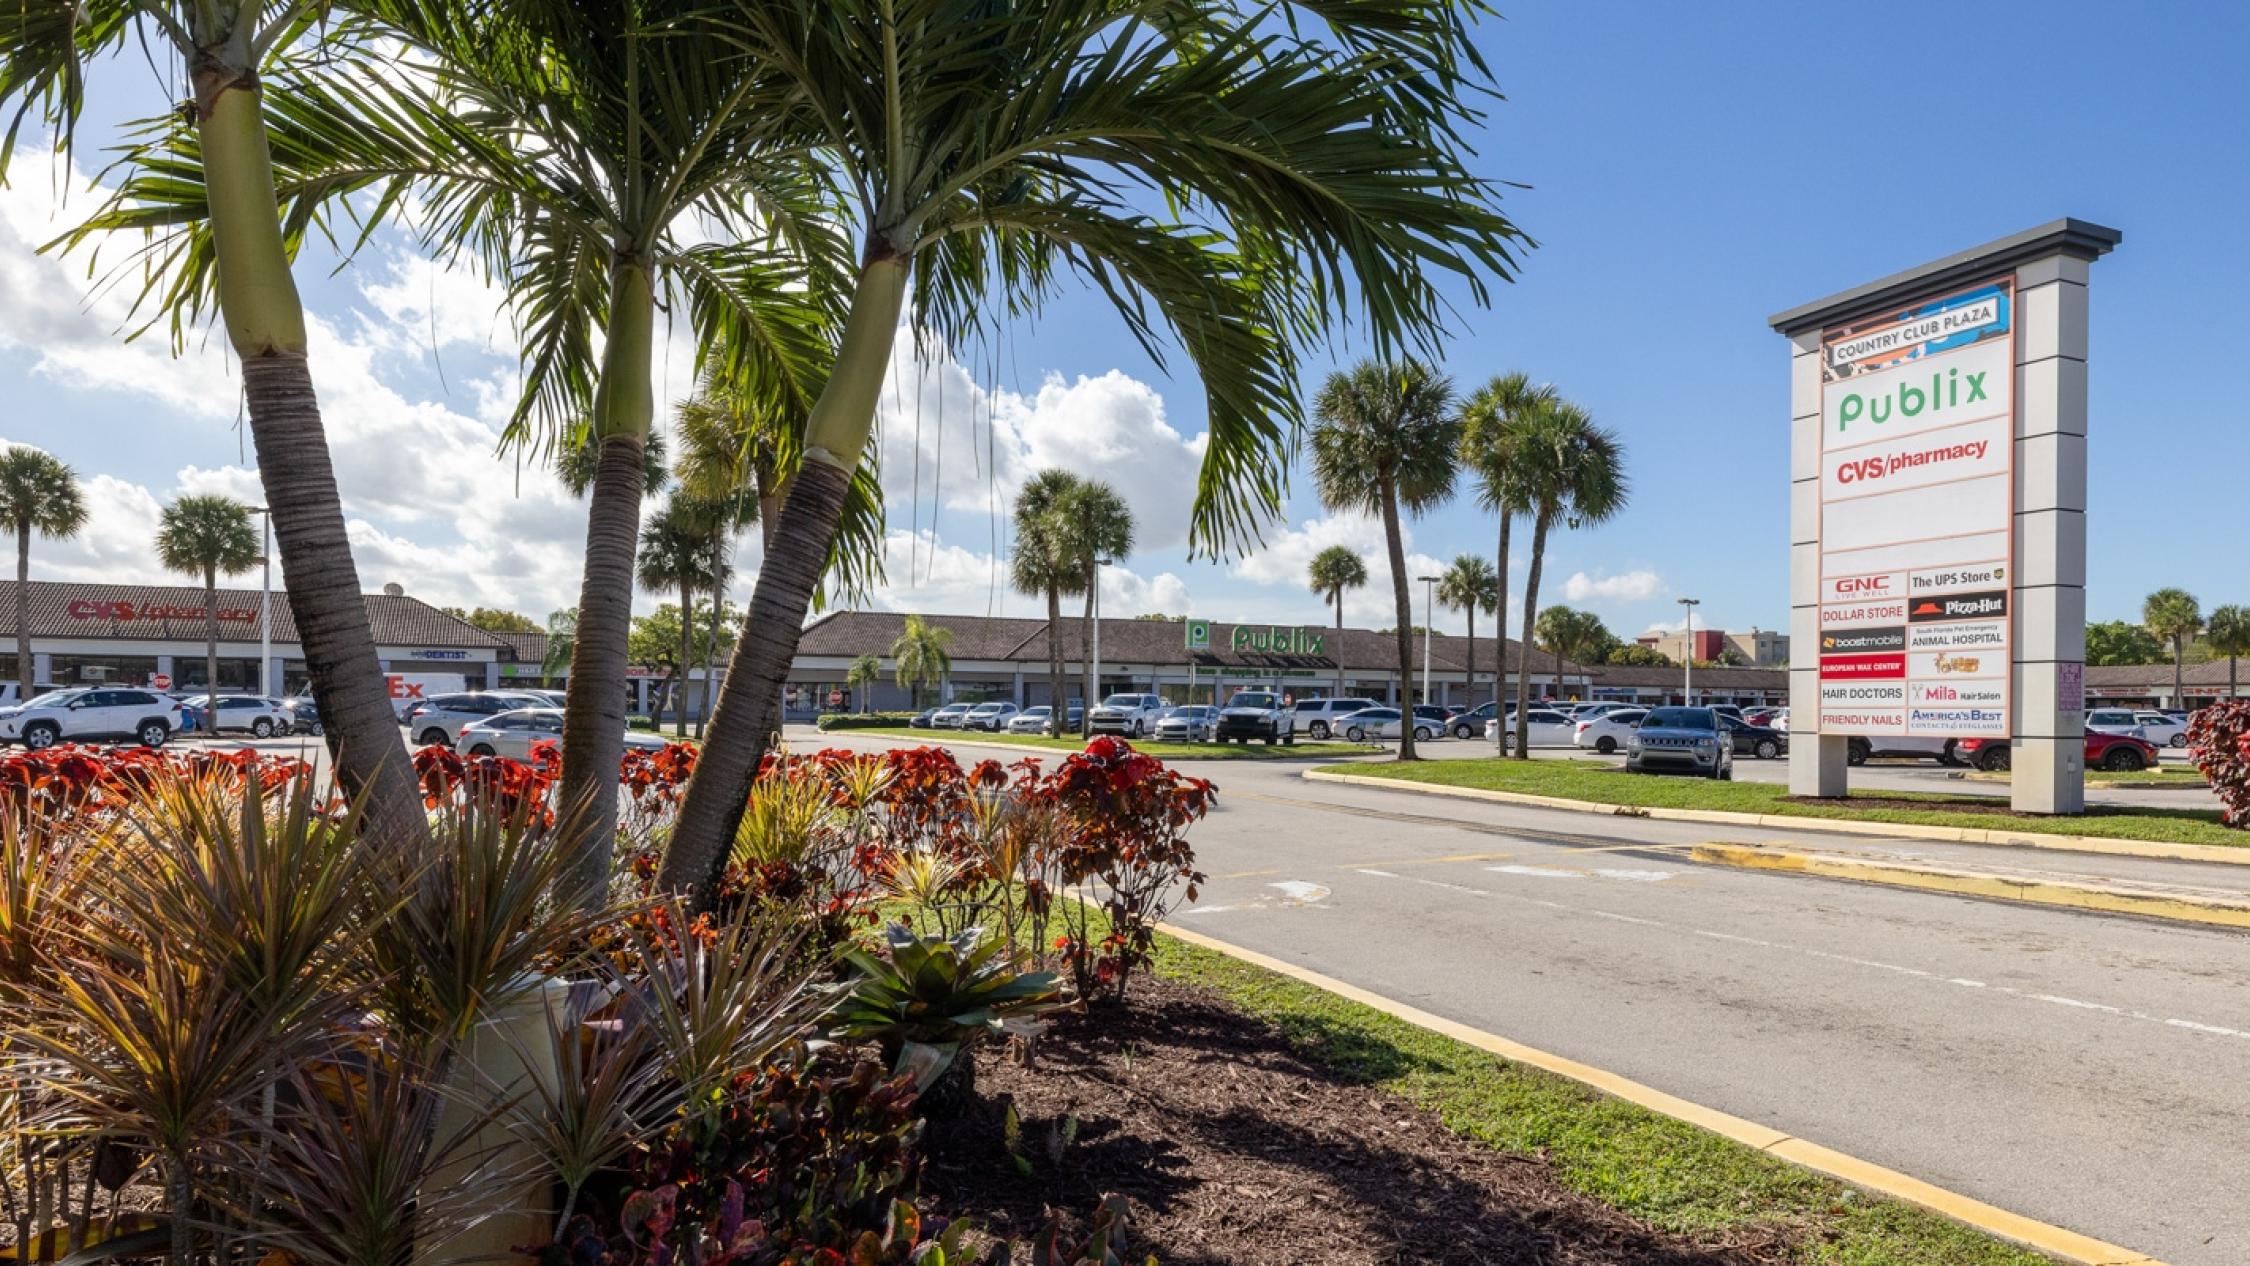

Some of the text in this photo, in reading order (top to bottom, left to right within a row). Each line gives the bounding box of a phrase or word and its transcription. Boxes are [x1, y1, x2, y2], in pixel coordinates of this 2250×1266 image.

[1837, 305, 1992, 360] COUNTRY CLUB PLAZA
[1839, 367, 1988, 432] Publix
[1837, 439, 1989, 485] CVS/pharmacy
[1835, 575, 1890, 592] GNC
[1912, 576, 1932, 588] The
[1934, 572, 1957, 586] UPS
[1961, 571, 1991, 584] Store
[1823, 605, 1903, 622] DOLLAR STORE
[1945, 598, 2003, 615] Pizza Hut
[1231, 625, 1325, 655] Publix
[1911, 633, 2003, 647] ANIMAL HOSPITAL
[1822, 662, 1902, 672] EUROPEAN WAX CENTER
[386, 676, 425, 698] Ex
[1822, 687, 1903, 699] HAIR DOCTORS
[1925, 685, 1957, 700] Mila
[1822, 714, 1903, 725] FRIENDLY NAILS
